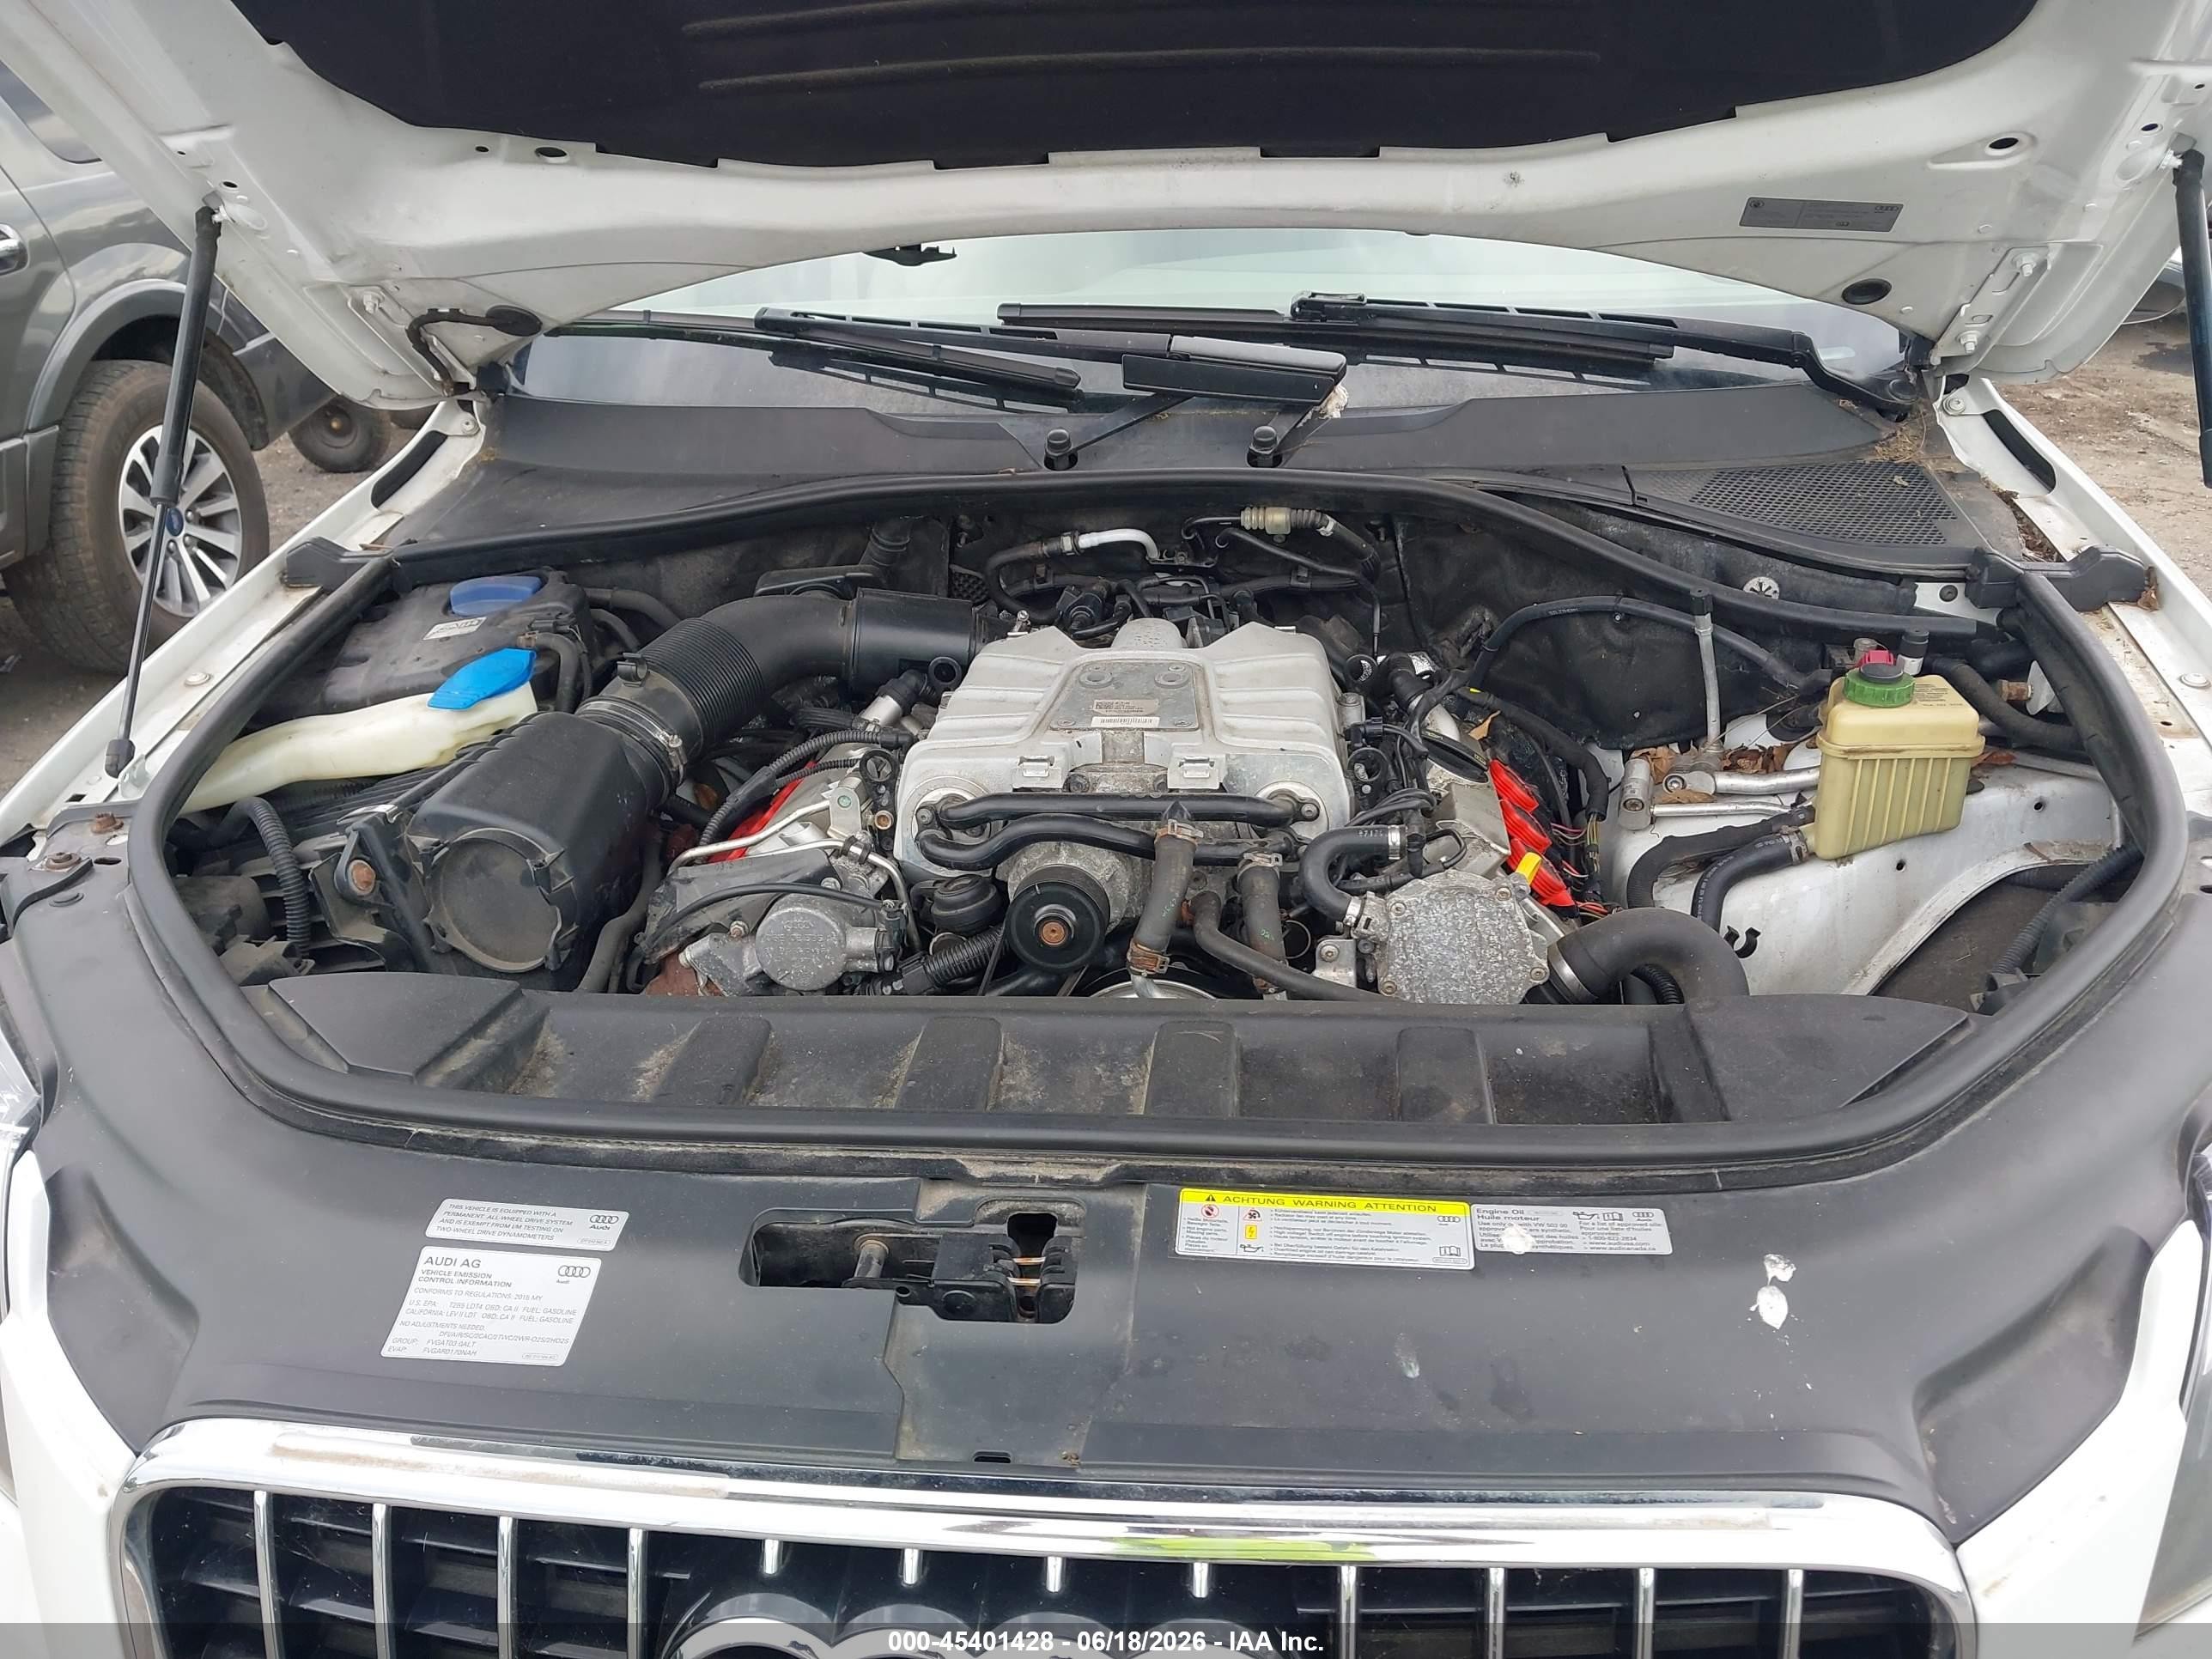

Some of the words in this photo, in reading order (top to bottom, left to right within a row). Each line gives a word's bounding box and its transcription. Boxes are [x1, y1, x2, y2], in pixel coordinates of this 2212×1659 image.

[1223, 1196, 1285, 1205] ACHTUNG
[1293, 1199, 1357, 1208] WARNING
[1364, 1202, 1436, 1212] ATTENTION
[436, 1226, 475, 1235] TWO-WHEEL
[497, 1231, 554, 1241] DYNAMOMETERS
[424, 1257, 457, 1267] AUDI
[460, 1258, 481, 1268] AG
[456, 1279, 512, 1288] INFORMATION
